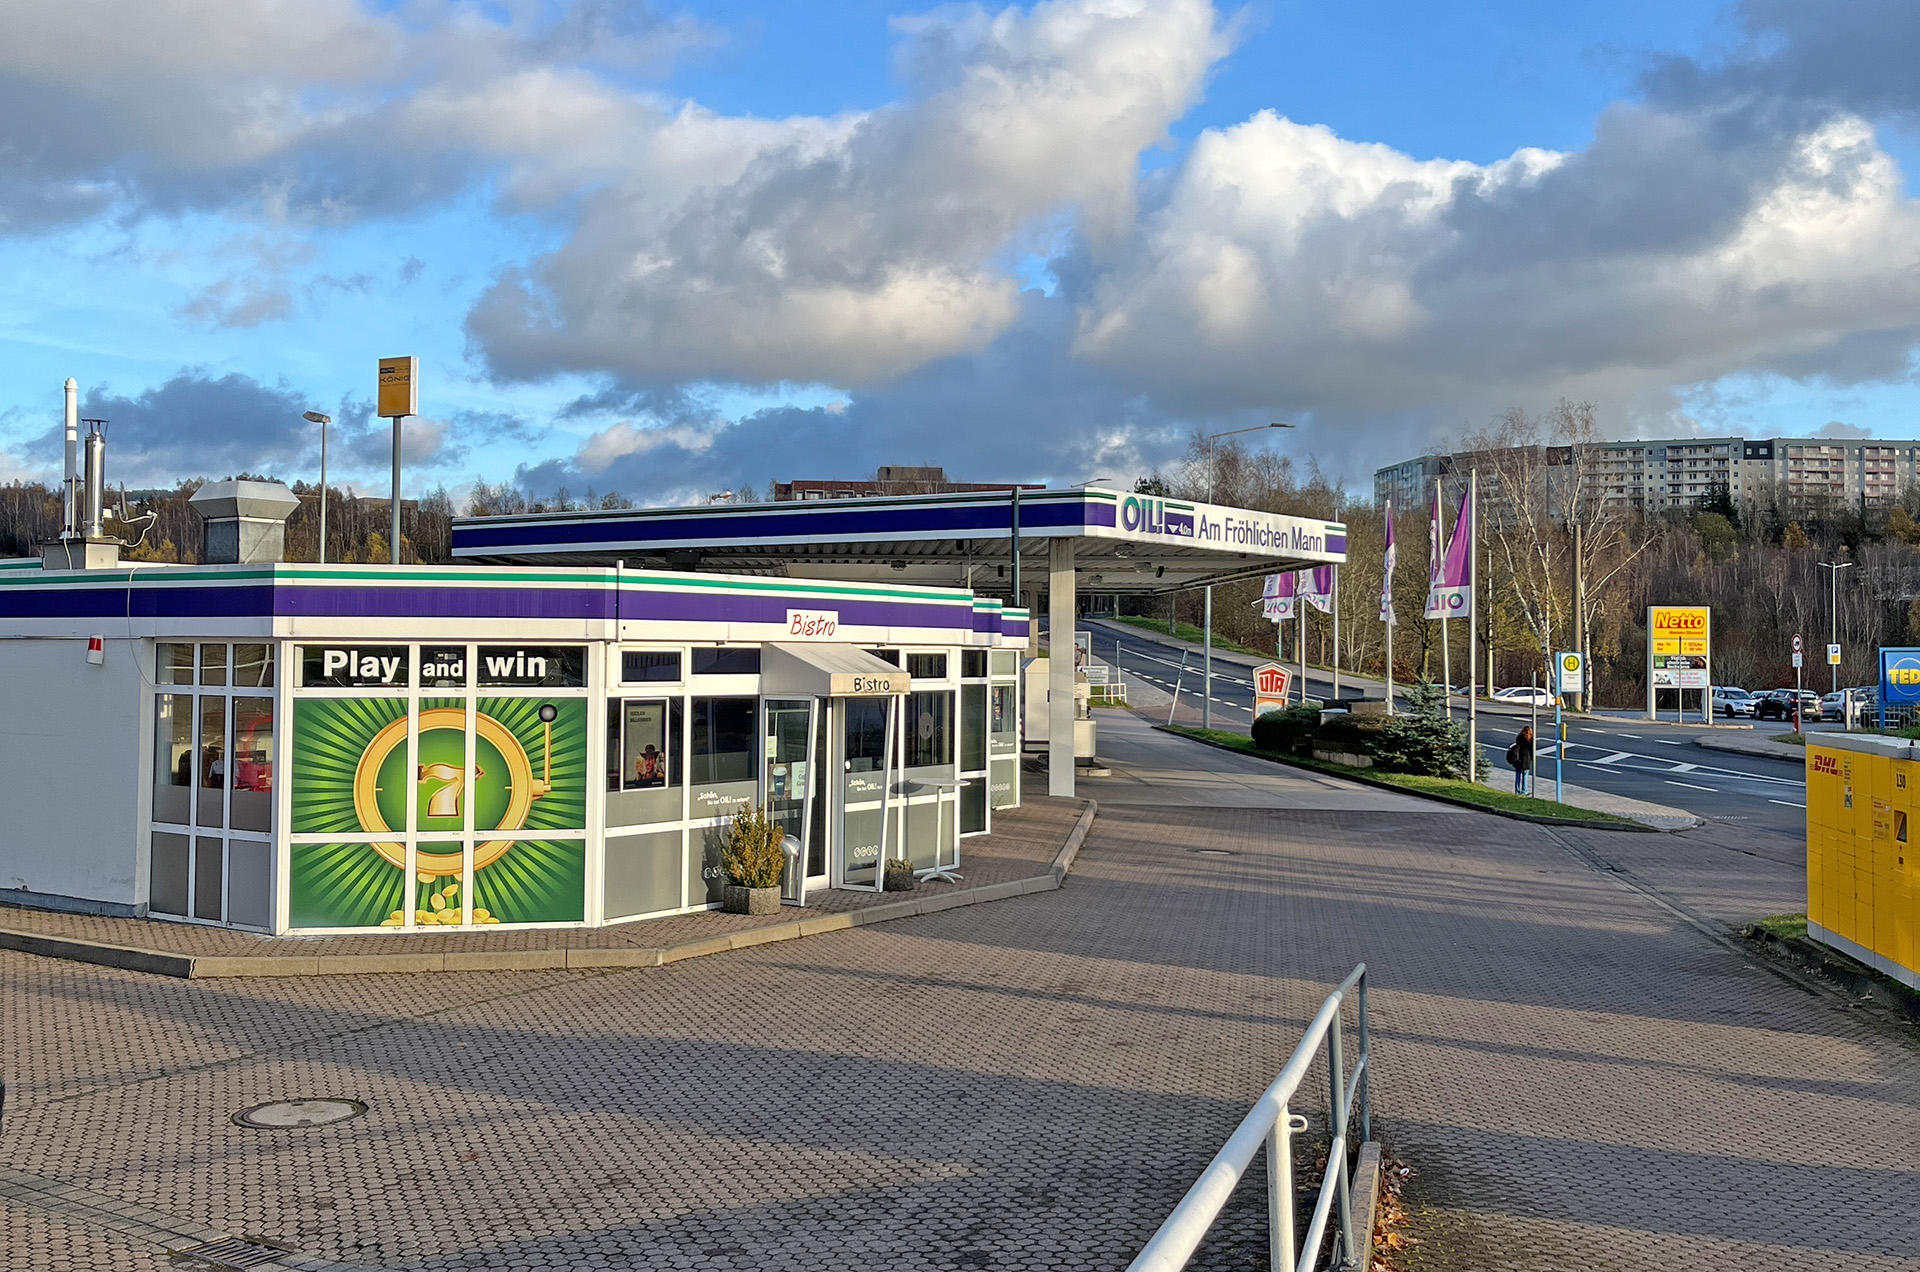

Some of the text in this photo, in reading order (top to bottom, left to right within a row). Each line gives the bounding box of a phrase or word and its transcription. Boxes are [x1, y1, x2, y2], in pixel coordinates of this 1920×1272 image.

[1121, 496, 1163, 535] OIL!
[1198, 514, 1323, 553] Am Fröhlichen Mann
[790, 613, 836, 636] Bistro
[1655, 611, 1705, 629] Netto
[323, 649, 547, 683] Play and win
[1567, 658, 1576, 668] H
[854, 676, 890, 692] Bistro
[1258, 668, 1286, 693] UTA
[1814, 754, 1838, 776] DHL
